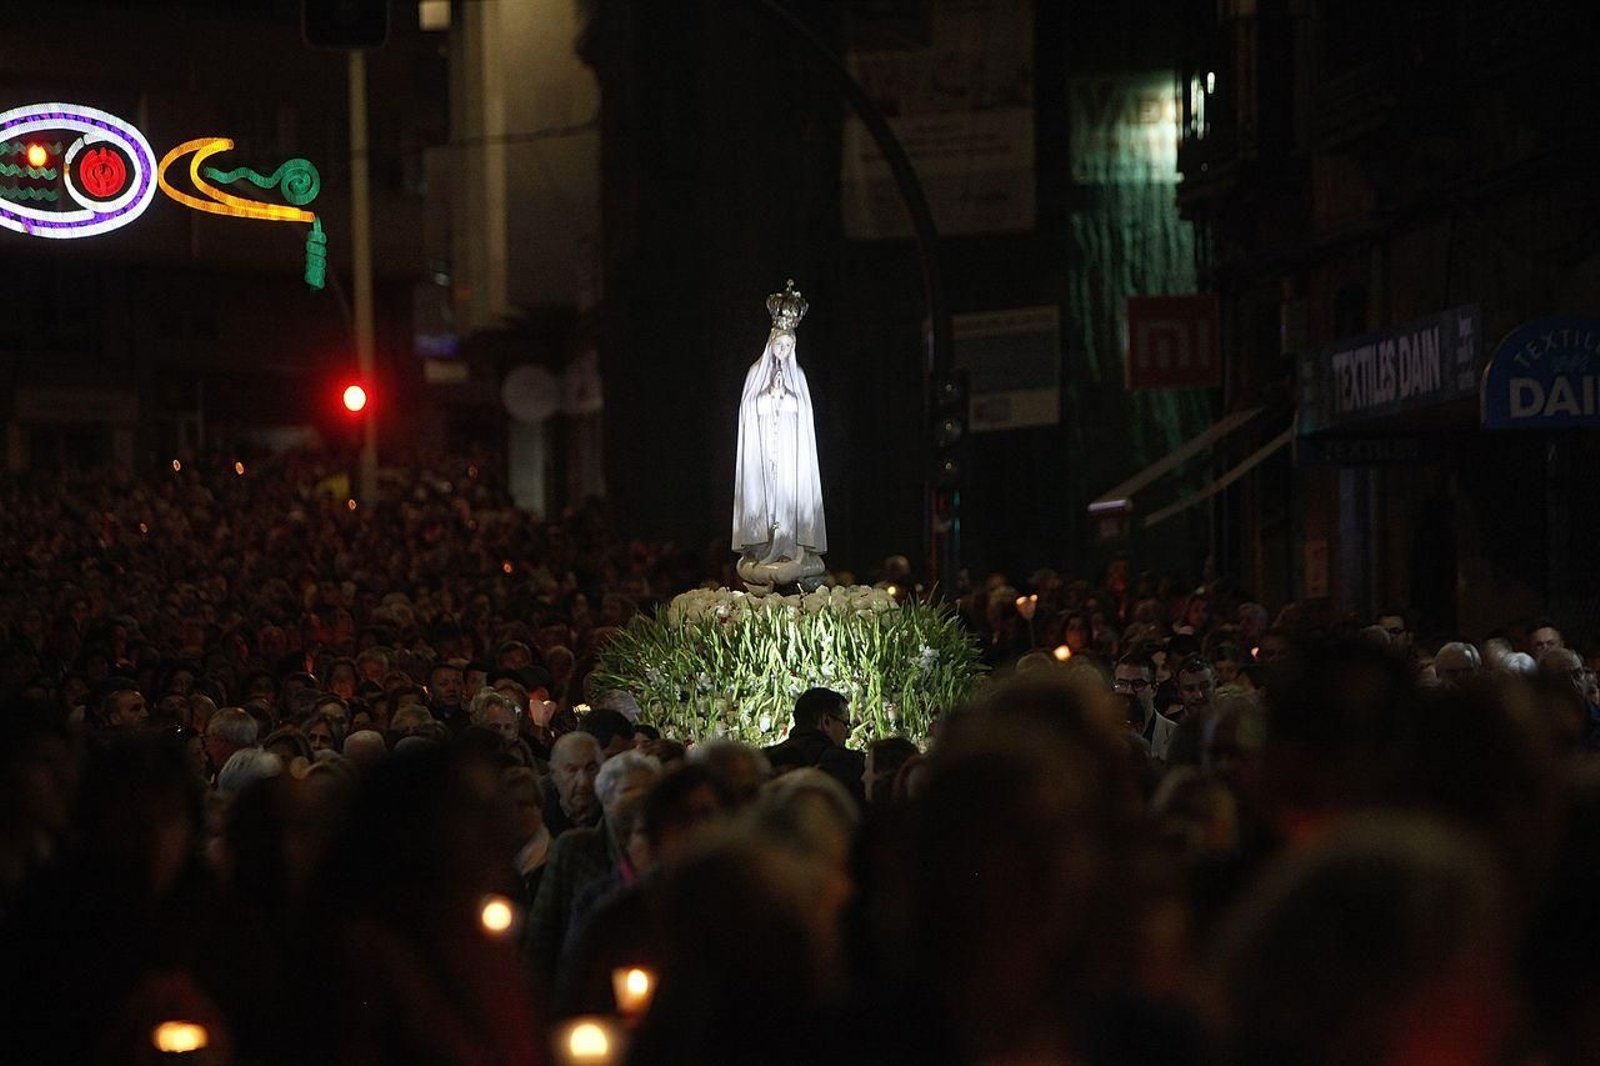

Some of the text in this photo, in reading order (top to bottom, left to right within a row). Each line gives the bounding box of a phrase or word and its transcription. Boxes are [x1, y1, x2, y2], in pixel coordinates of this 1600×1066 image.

[1331, 339, 1397, 413] TEXTILES
[1398, 325, 1441, 399] DAIN
[1508, 375, 1600, 419] DAI
